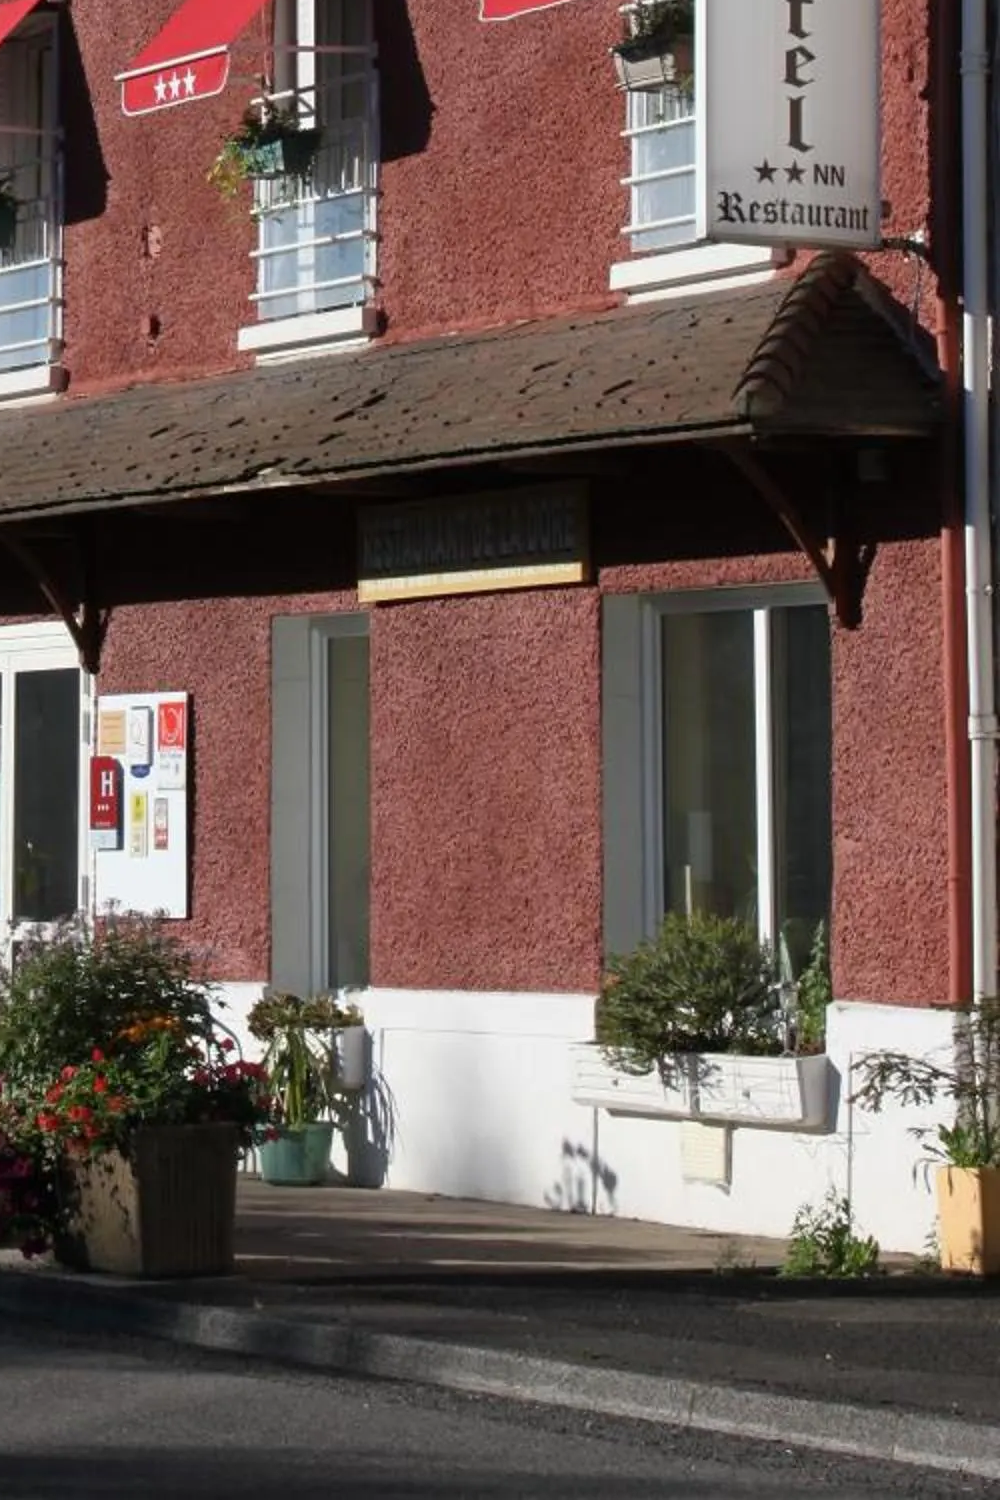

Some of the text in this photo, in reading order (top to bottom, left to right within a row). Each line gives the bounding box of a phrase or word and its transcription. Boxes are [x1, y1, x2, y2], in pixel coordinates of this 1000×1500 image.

[813, 163, 846, 187] NN
[717, 190, 870, 233] Restaurant
[101, 771, 115, 797] H
